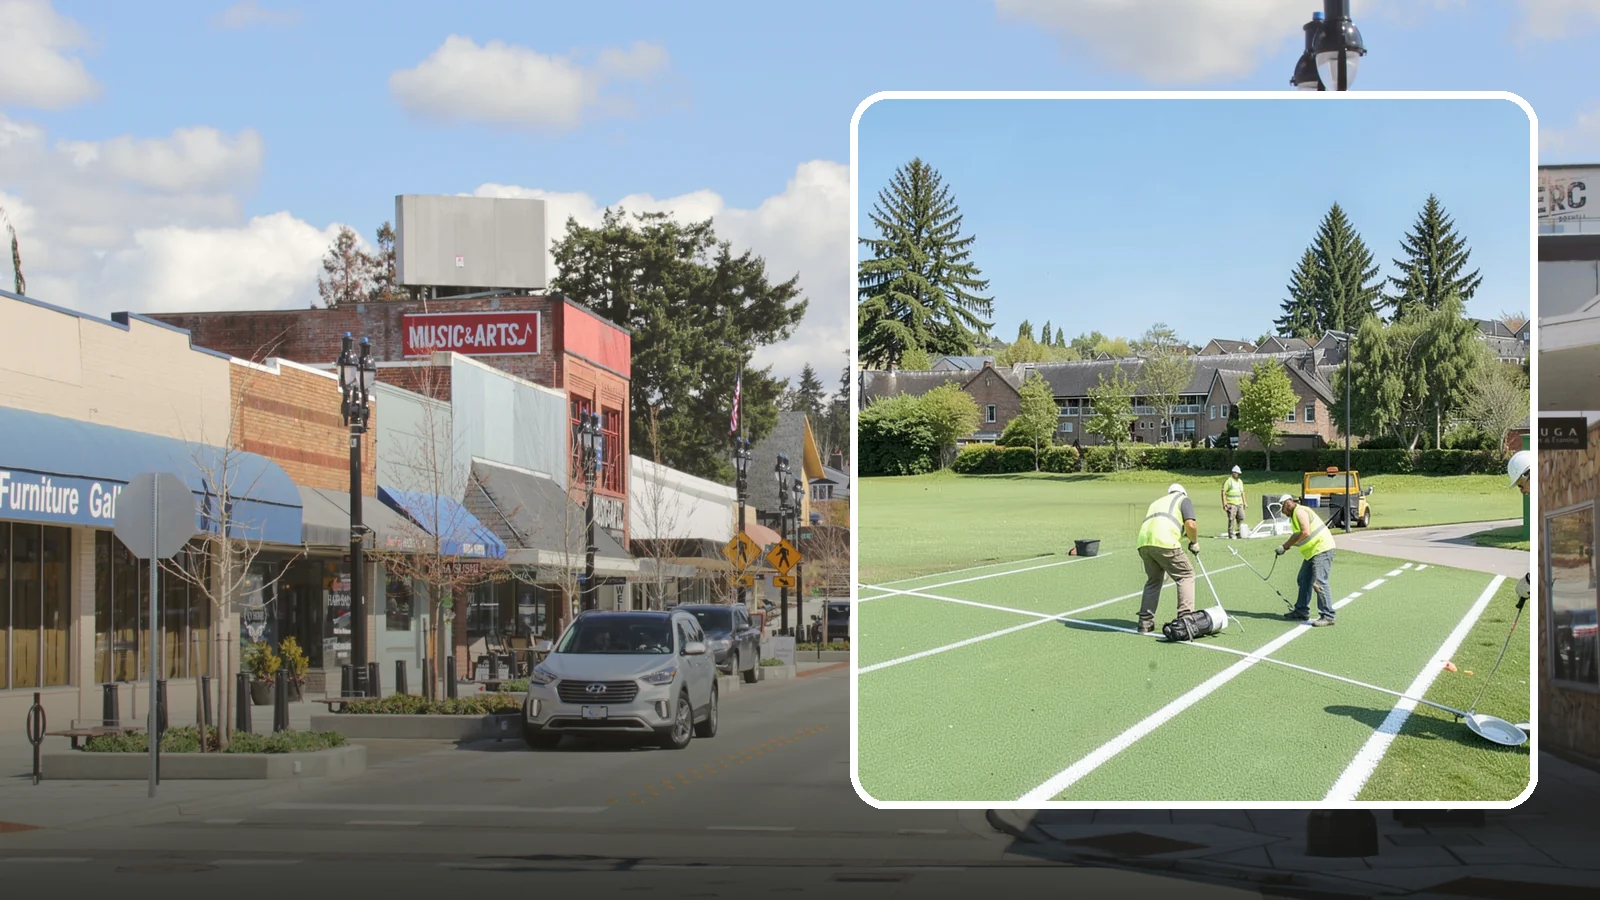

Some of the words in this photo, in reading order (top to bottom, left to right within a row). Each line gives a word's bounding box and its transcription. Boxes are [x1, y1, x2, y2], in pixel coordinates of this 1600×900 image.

[409, 323, 519, 349] MUSIC&ARTS
[0, 471, 79, 515] Furniture
[90, 482, 121, 519] Gal
[453, 563, 479, 574] SUSHI
